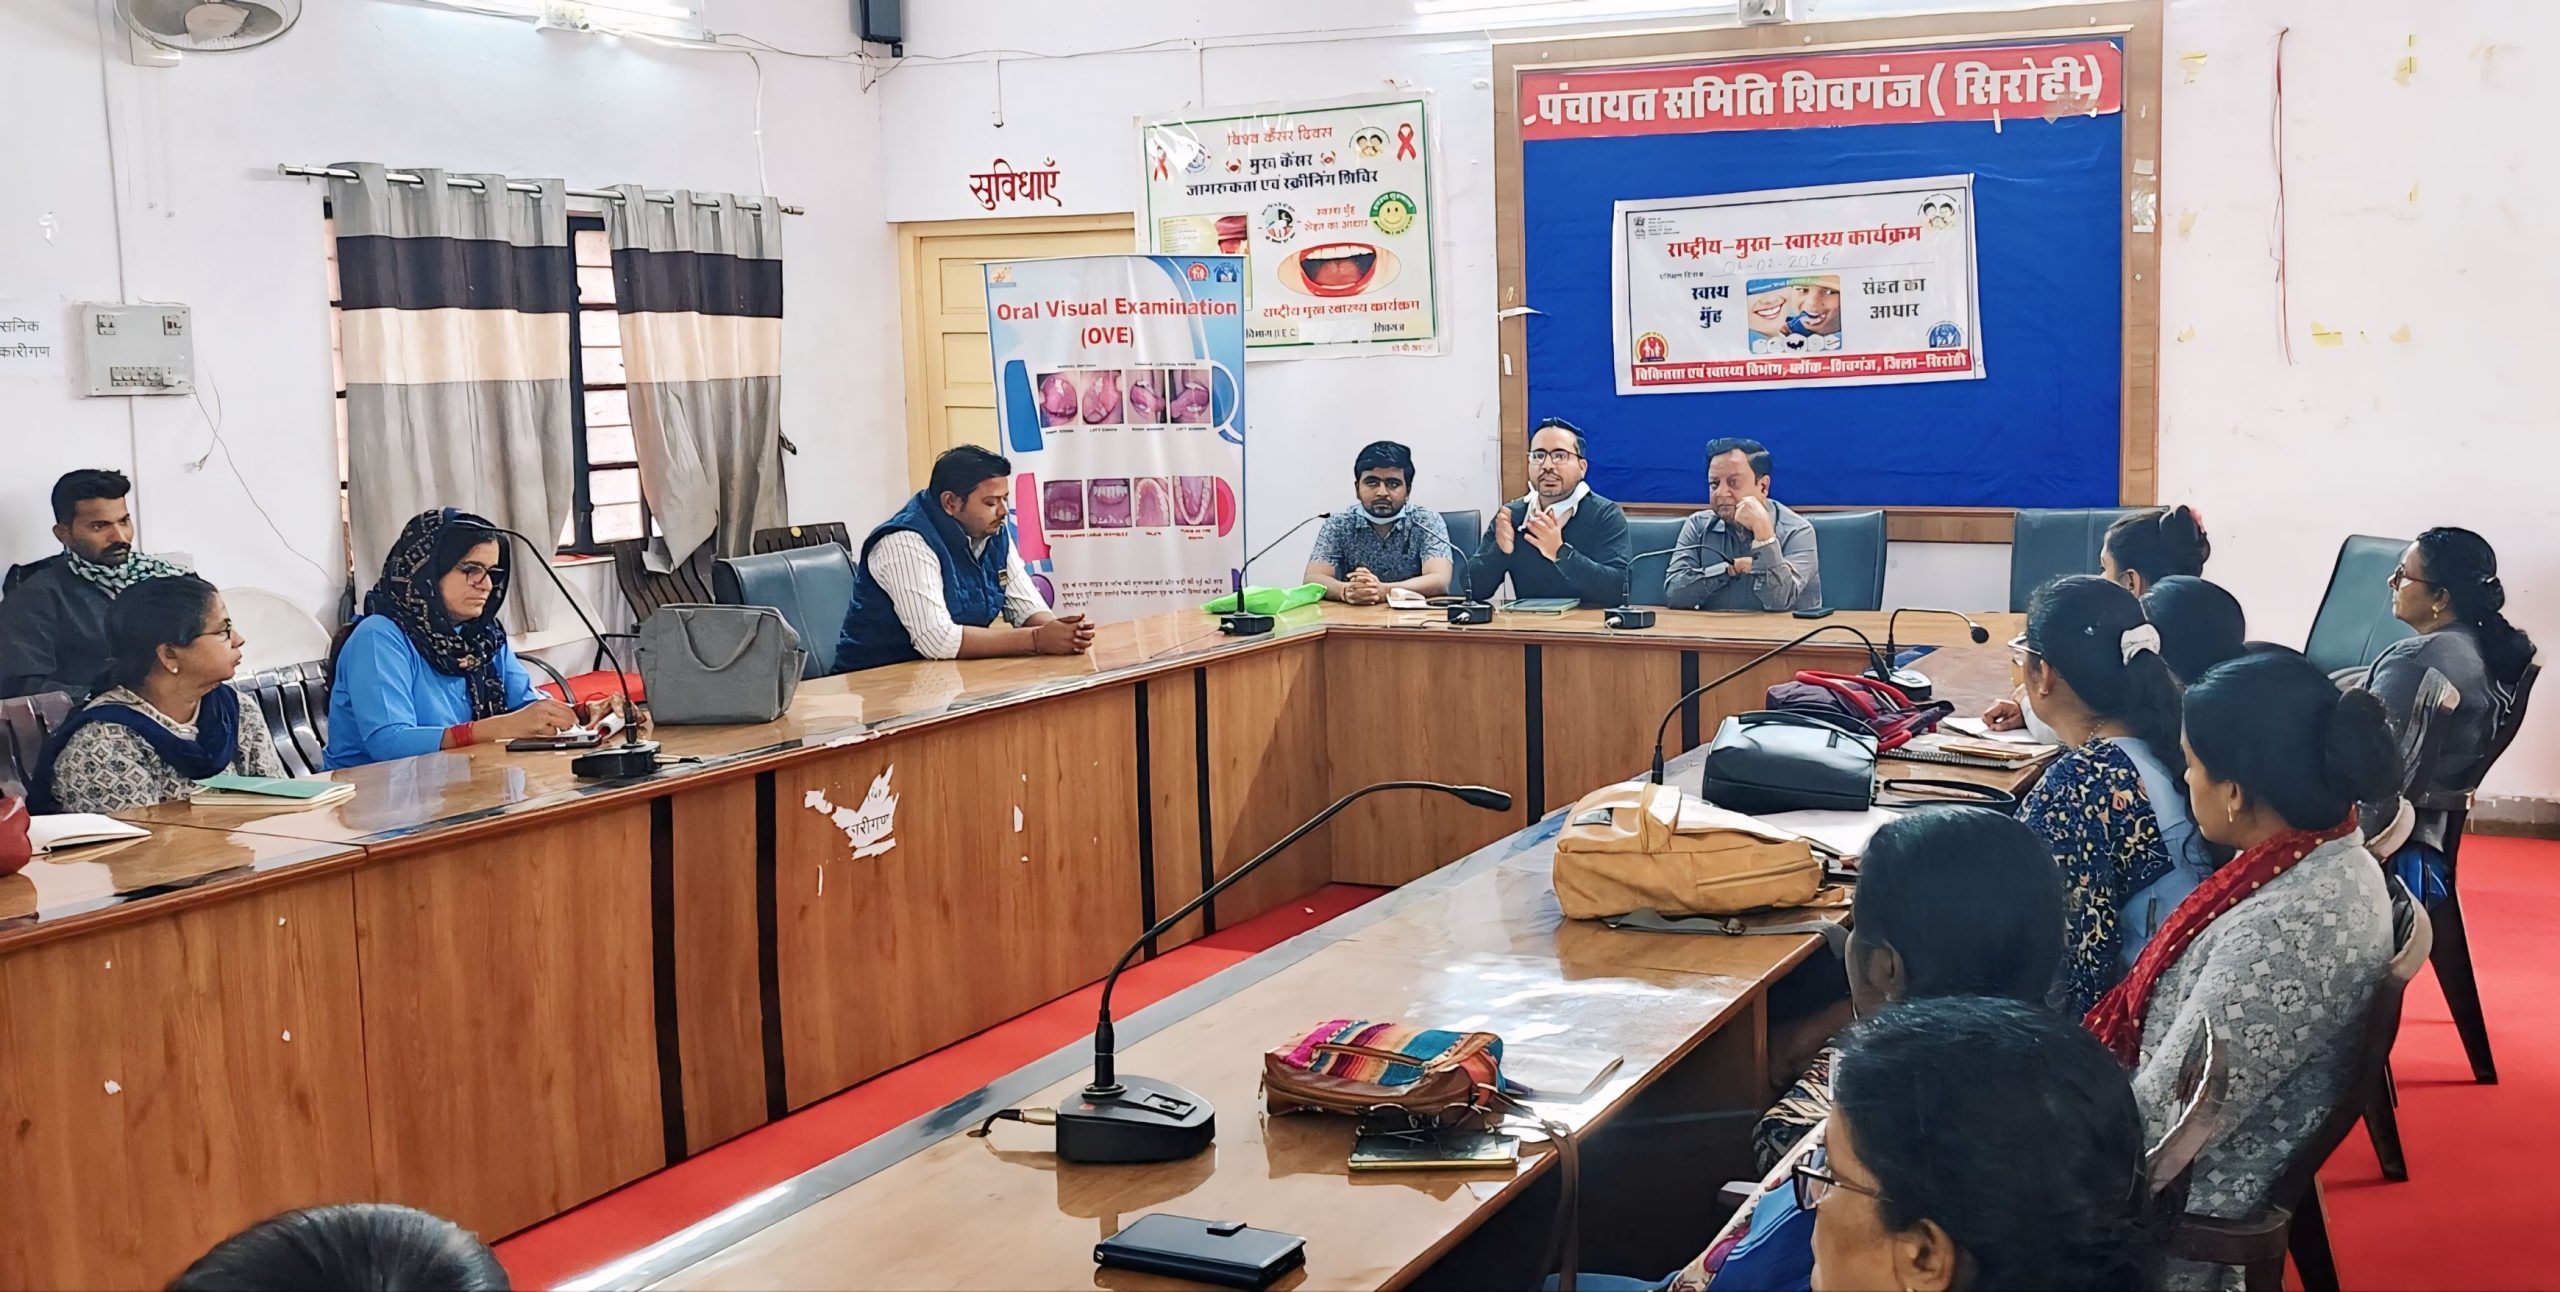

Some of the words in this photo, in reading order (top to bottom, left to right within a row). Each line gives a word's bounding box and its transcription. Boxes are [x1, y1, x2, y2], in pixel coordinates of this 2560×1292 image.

[1539, 82, 1656, 126] पंचायत
[1663, 73, 1777, 119] समिति
[1782, 64, 1924, 114] शिवगंज
[1298, 125, 1333, 141] दिवस
[1250, 157, 1277, 175] मुख
[1280, 151, 1313, 168] कैंसर
[969, 156, 1062, 211] सुविधाएँ
[1261, 174, 1280, 191] एवं
[1283, 171, 1336, 191] स्क्रीनिंग
[1339, 168, 1379, 185] शिविर
[1847, 223, 1922, 246] कार्यक्रम
[1691, 285, 1730, 300] स्वस्थ
[1862, 278, 1899, 296] सेहत
[1904, 278, 1926, 293] का
[997, 301, 1039, 320] Oral
[1046, 298, 1107, 318] Visual
[1115, 297, 1237, 316] Examination
[1869, 303, 1920, 319] आधार
[1081, 327, 1134, 349] (OVE)
